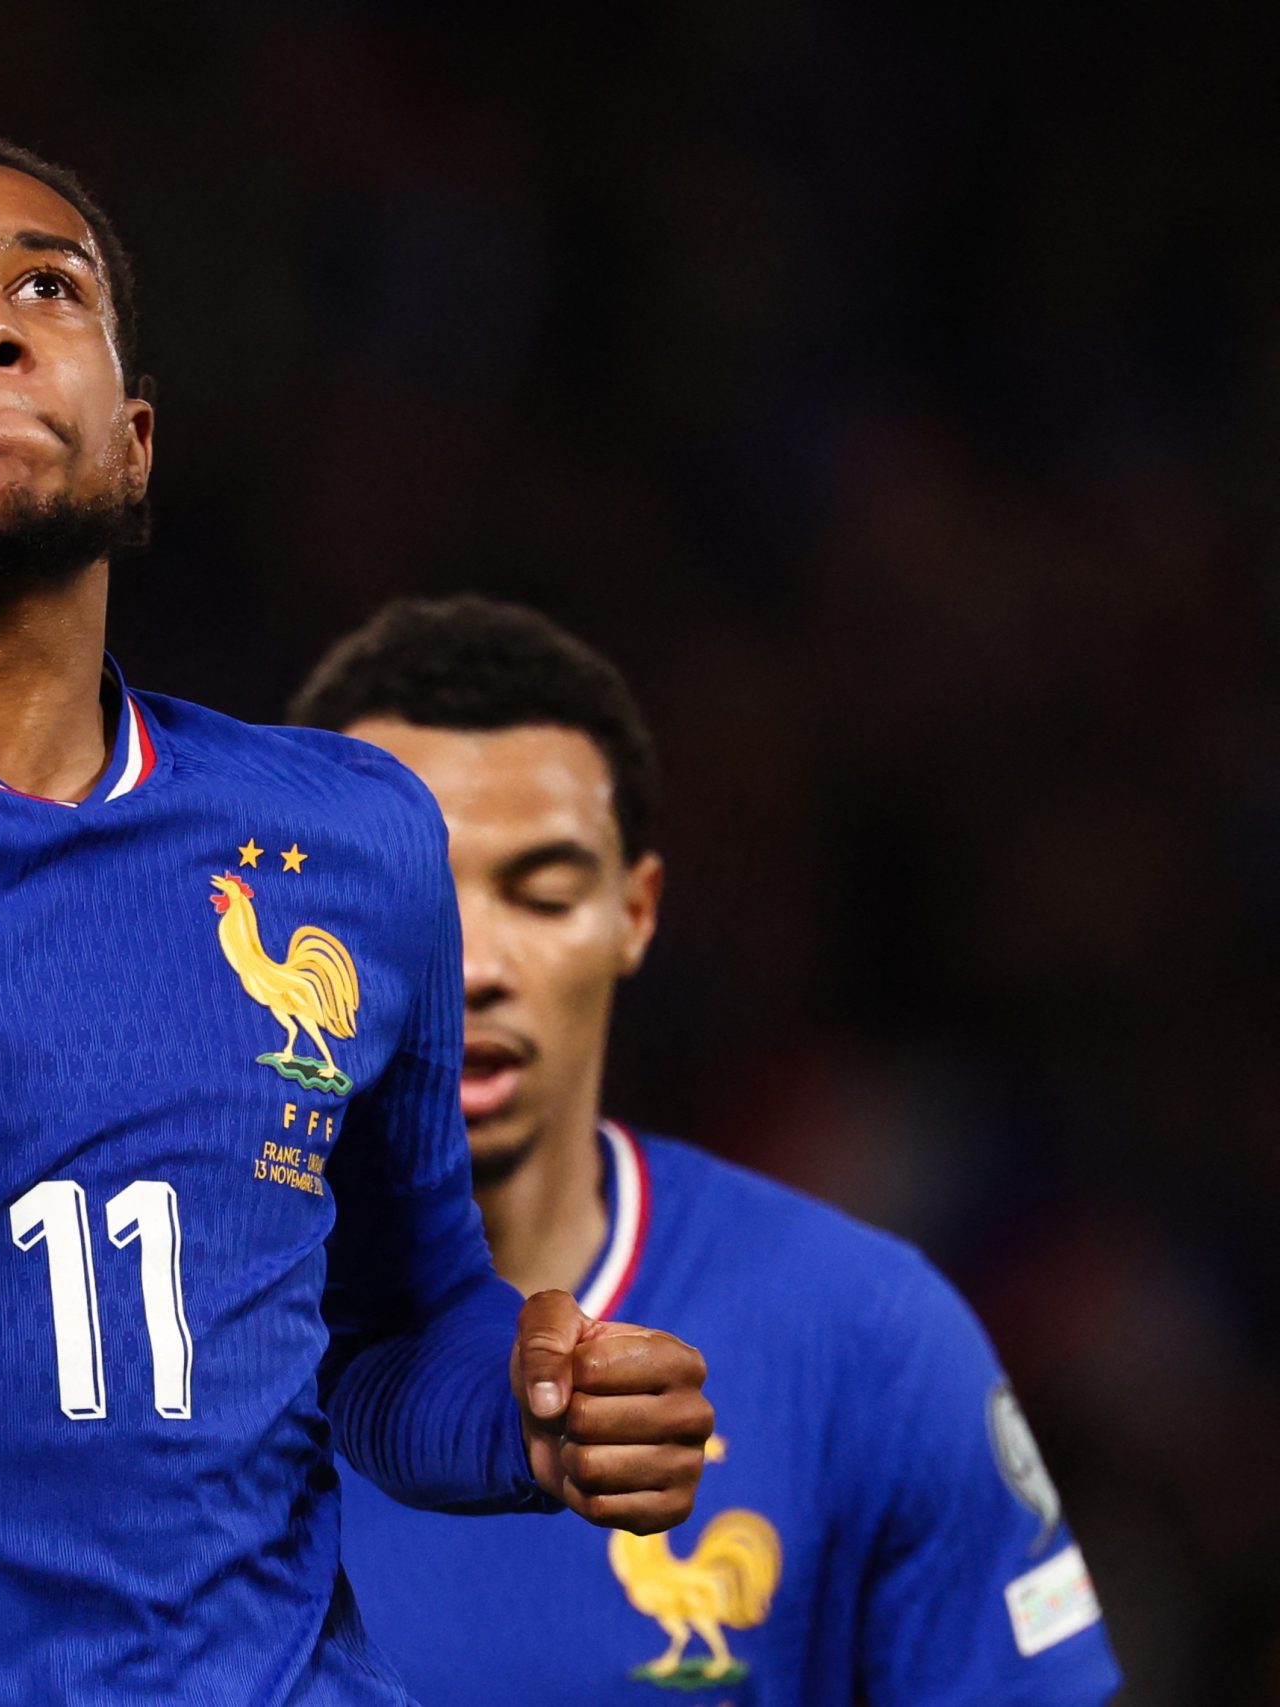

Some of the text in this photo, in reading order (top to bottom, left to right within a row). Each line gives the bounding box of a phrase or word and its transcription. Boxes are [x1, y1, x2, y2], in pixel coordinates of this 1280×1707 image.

[263, 1141, 301, 1167] FRANCE
[254, 1159, 267, 1179] 13
[269, 1164, 314, 1192] NOVEMBRE
[9, 1180, 193, 1420] 11
